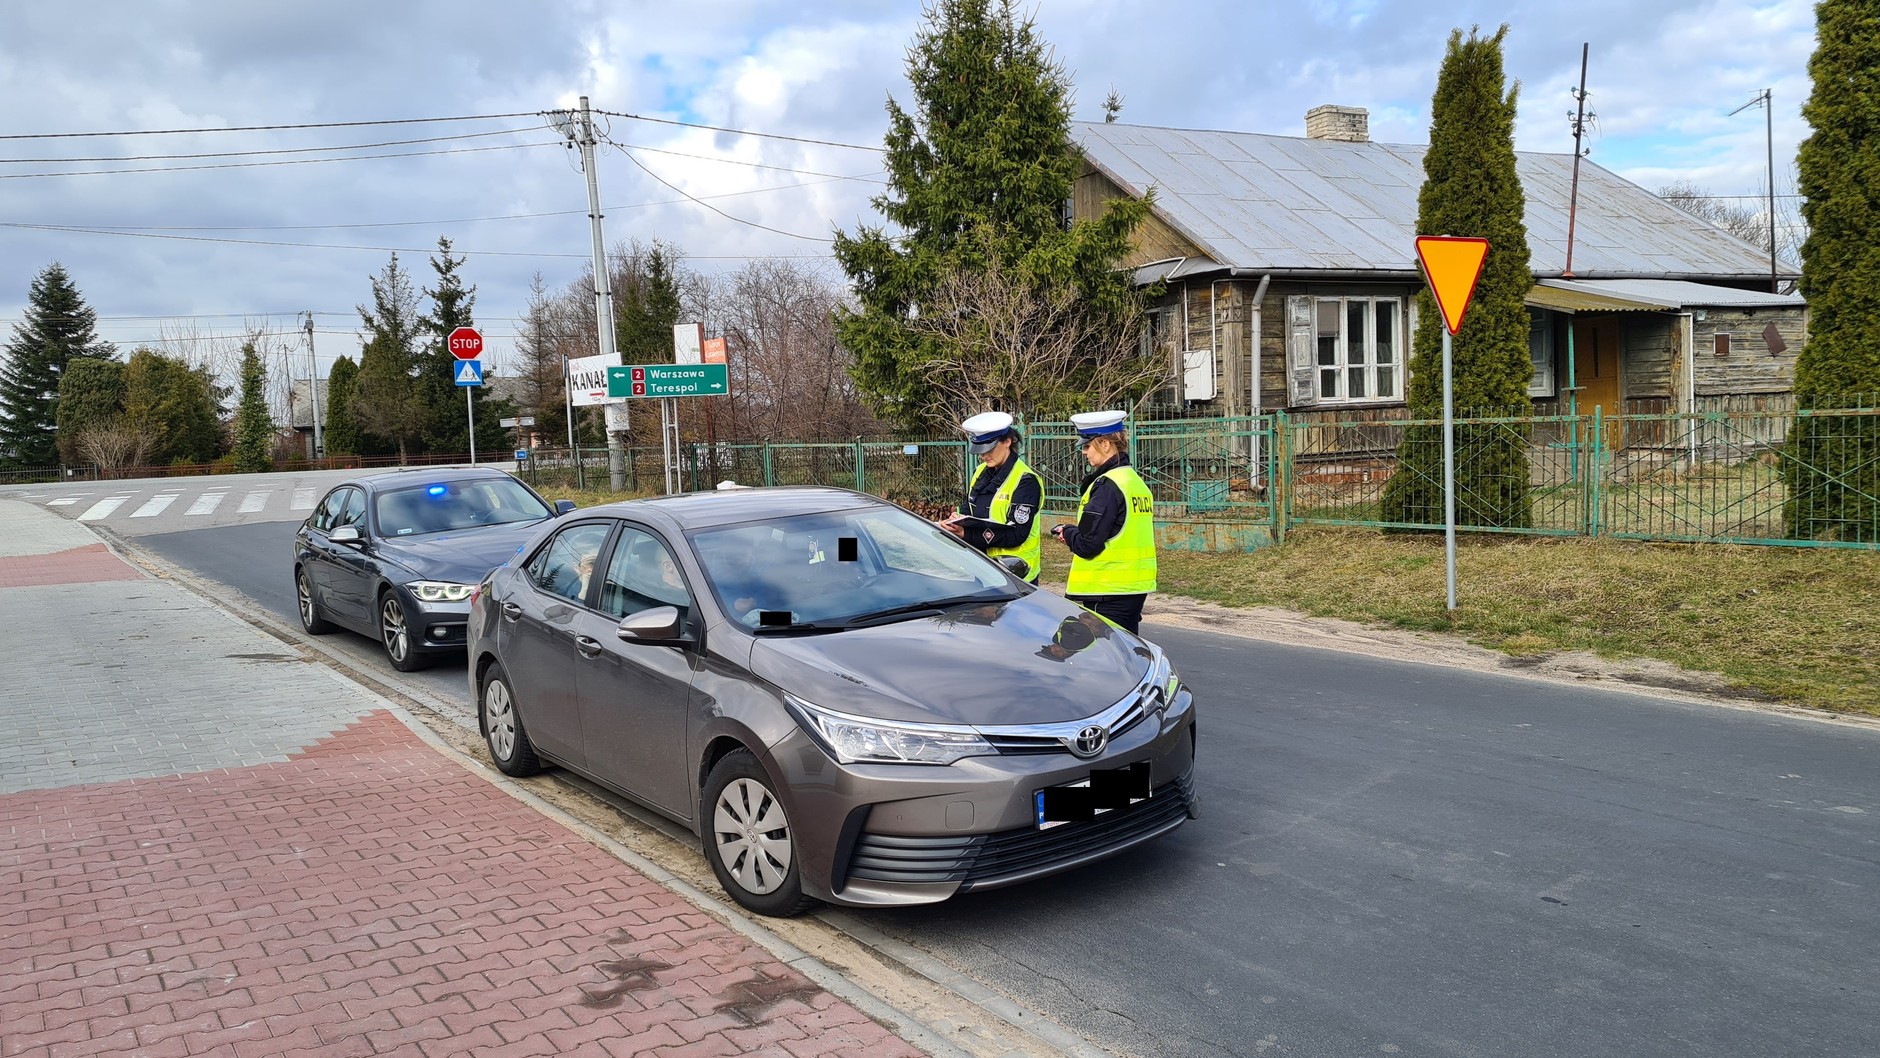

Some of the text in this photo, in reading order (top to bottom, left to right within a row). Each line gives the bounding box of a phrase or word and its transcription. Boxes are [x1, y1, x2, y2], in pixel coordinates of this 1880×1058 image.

[452, 338, 480, 349] STOP
[635, 369, 705, 379] 2 Warszawa
[636, 382, 698, 394] 2 Terespol
